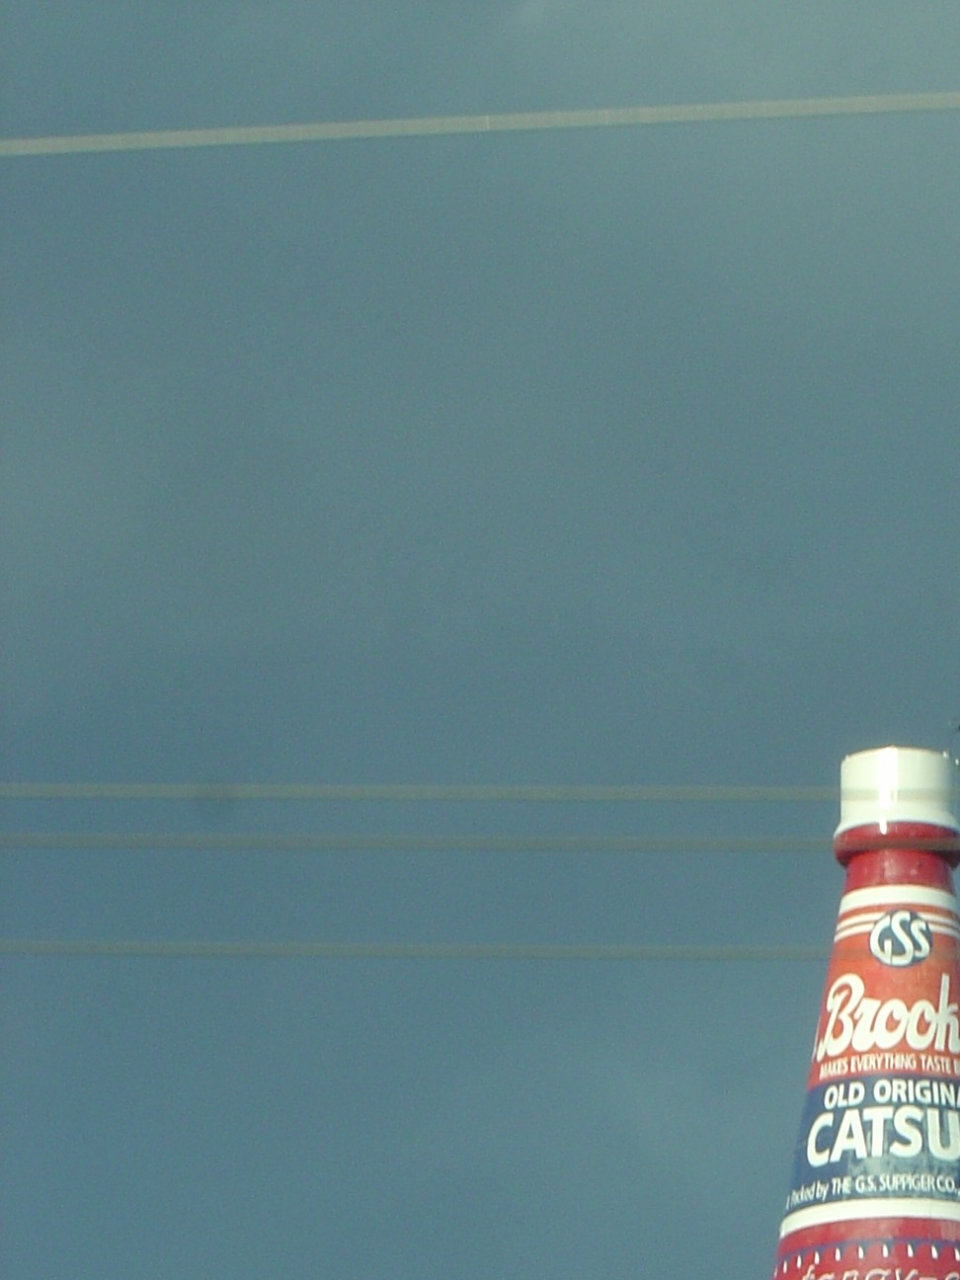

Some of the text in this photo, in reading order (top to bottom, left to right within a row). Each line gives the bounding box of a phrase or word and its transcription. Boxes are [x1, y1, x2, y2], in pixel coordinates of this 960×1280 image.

[851, 1052, 917, 1074] EVERYTHING
[920, 1054, 951, 1074] TASTE
[824, 1082, 865, 1110] OLD
[831, 1176, 852, 1196] THE
